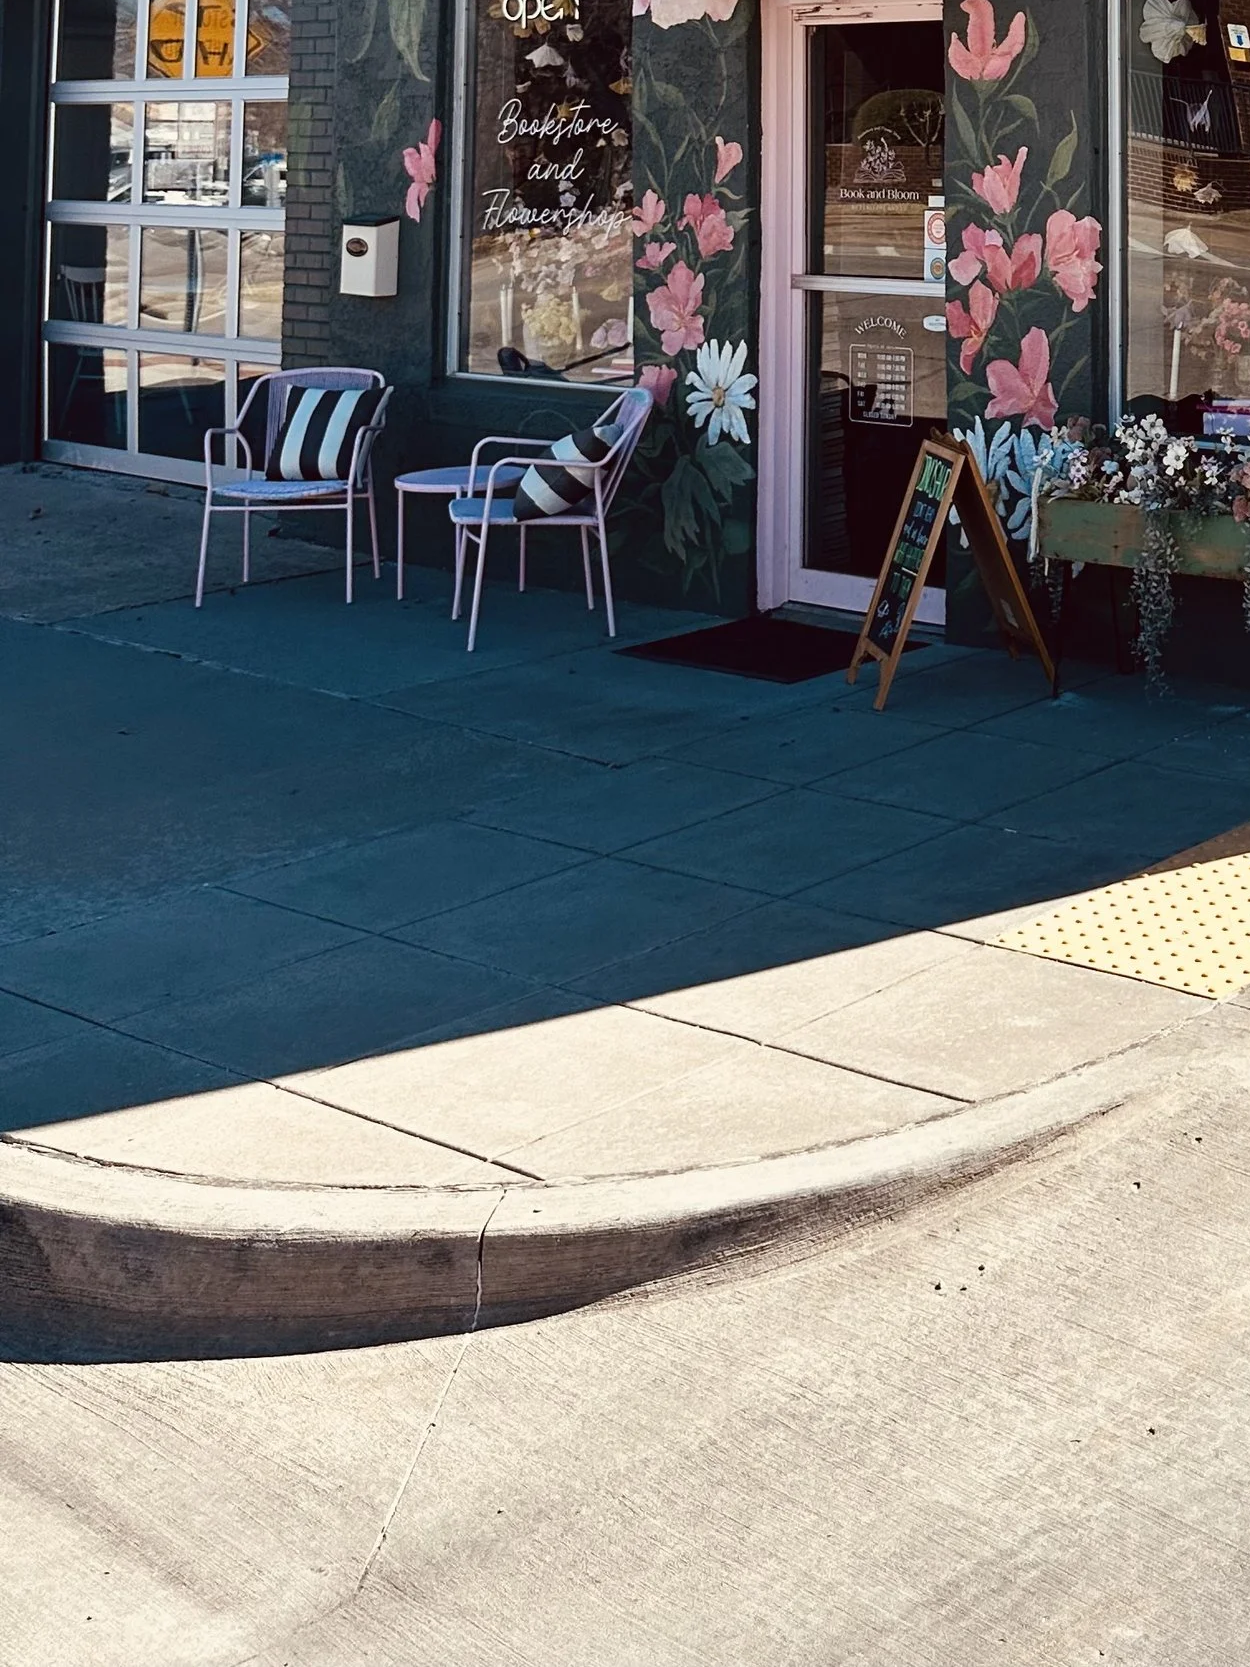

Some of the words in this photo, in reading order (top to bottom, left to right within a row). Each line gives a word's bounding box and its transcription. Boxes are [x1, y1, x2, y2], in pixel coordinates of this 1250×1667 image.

[497, 98, 619, 145] Bookstore
[527, 148, 585, 180] and
[839, 187, 865, 199] Book
[866, 188, 886, 200] and
[887, 188, 920, 201] Bloom
[481, 188, 633, 240] Flowershop
[854, 315, 907, 340] WELCOME
